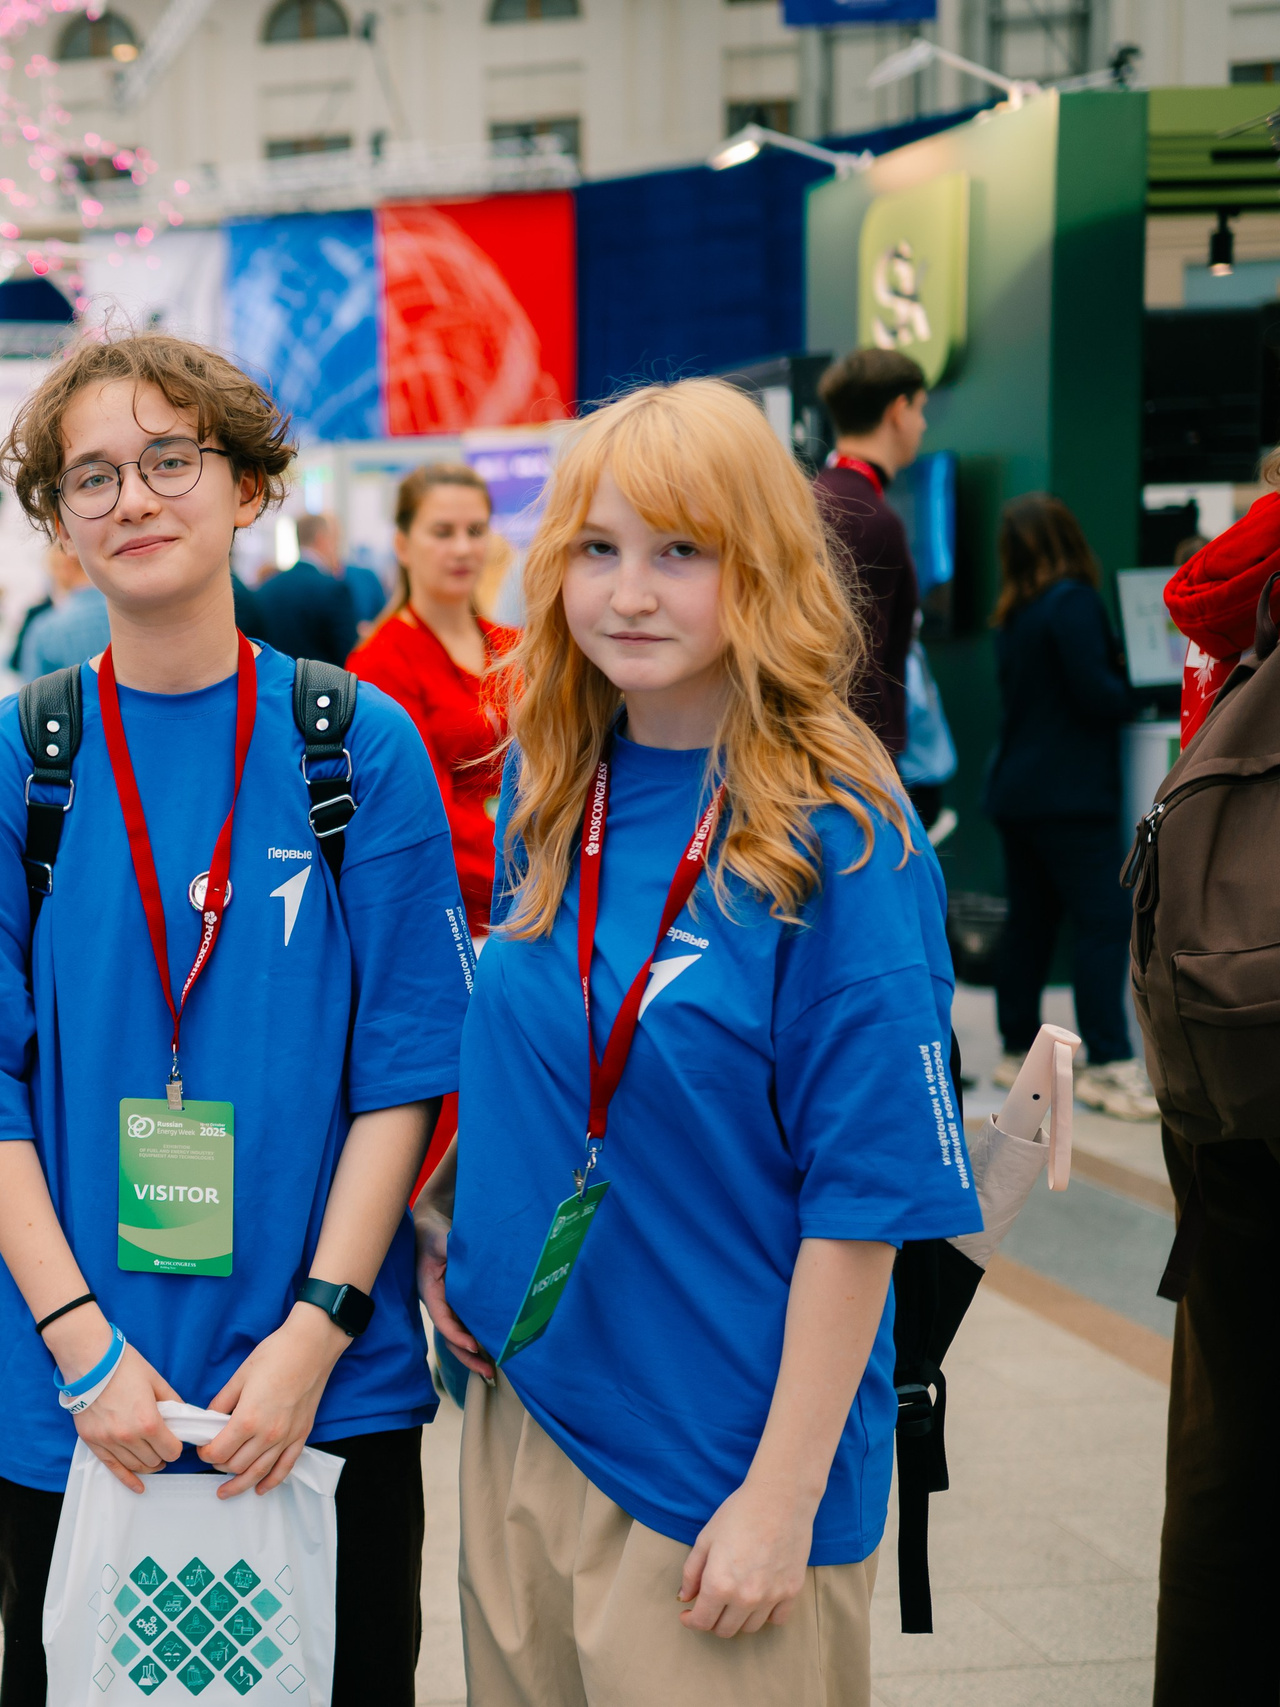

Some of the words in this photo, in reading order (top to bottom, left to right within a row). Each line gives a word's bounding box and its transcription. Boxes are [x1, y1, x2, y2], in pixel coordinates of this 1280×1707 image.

[588, 761, 608, 842] ROSCONGRESS
[267, 847, 313, 862] Первые
[666, 926, 710, 950] ервые
[445, 908, 463, 941] детей
[459, 952, 475, 995] молод
[157, 1128, 177, 1136] Energy
[200, 1127, 226, 1137] 2025
[947, 1122, 970, 1190] движение
[134, 1184, 220, 1204] VISITOR
